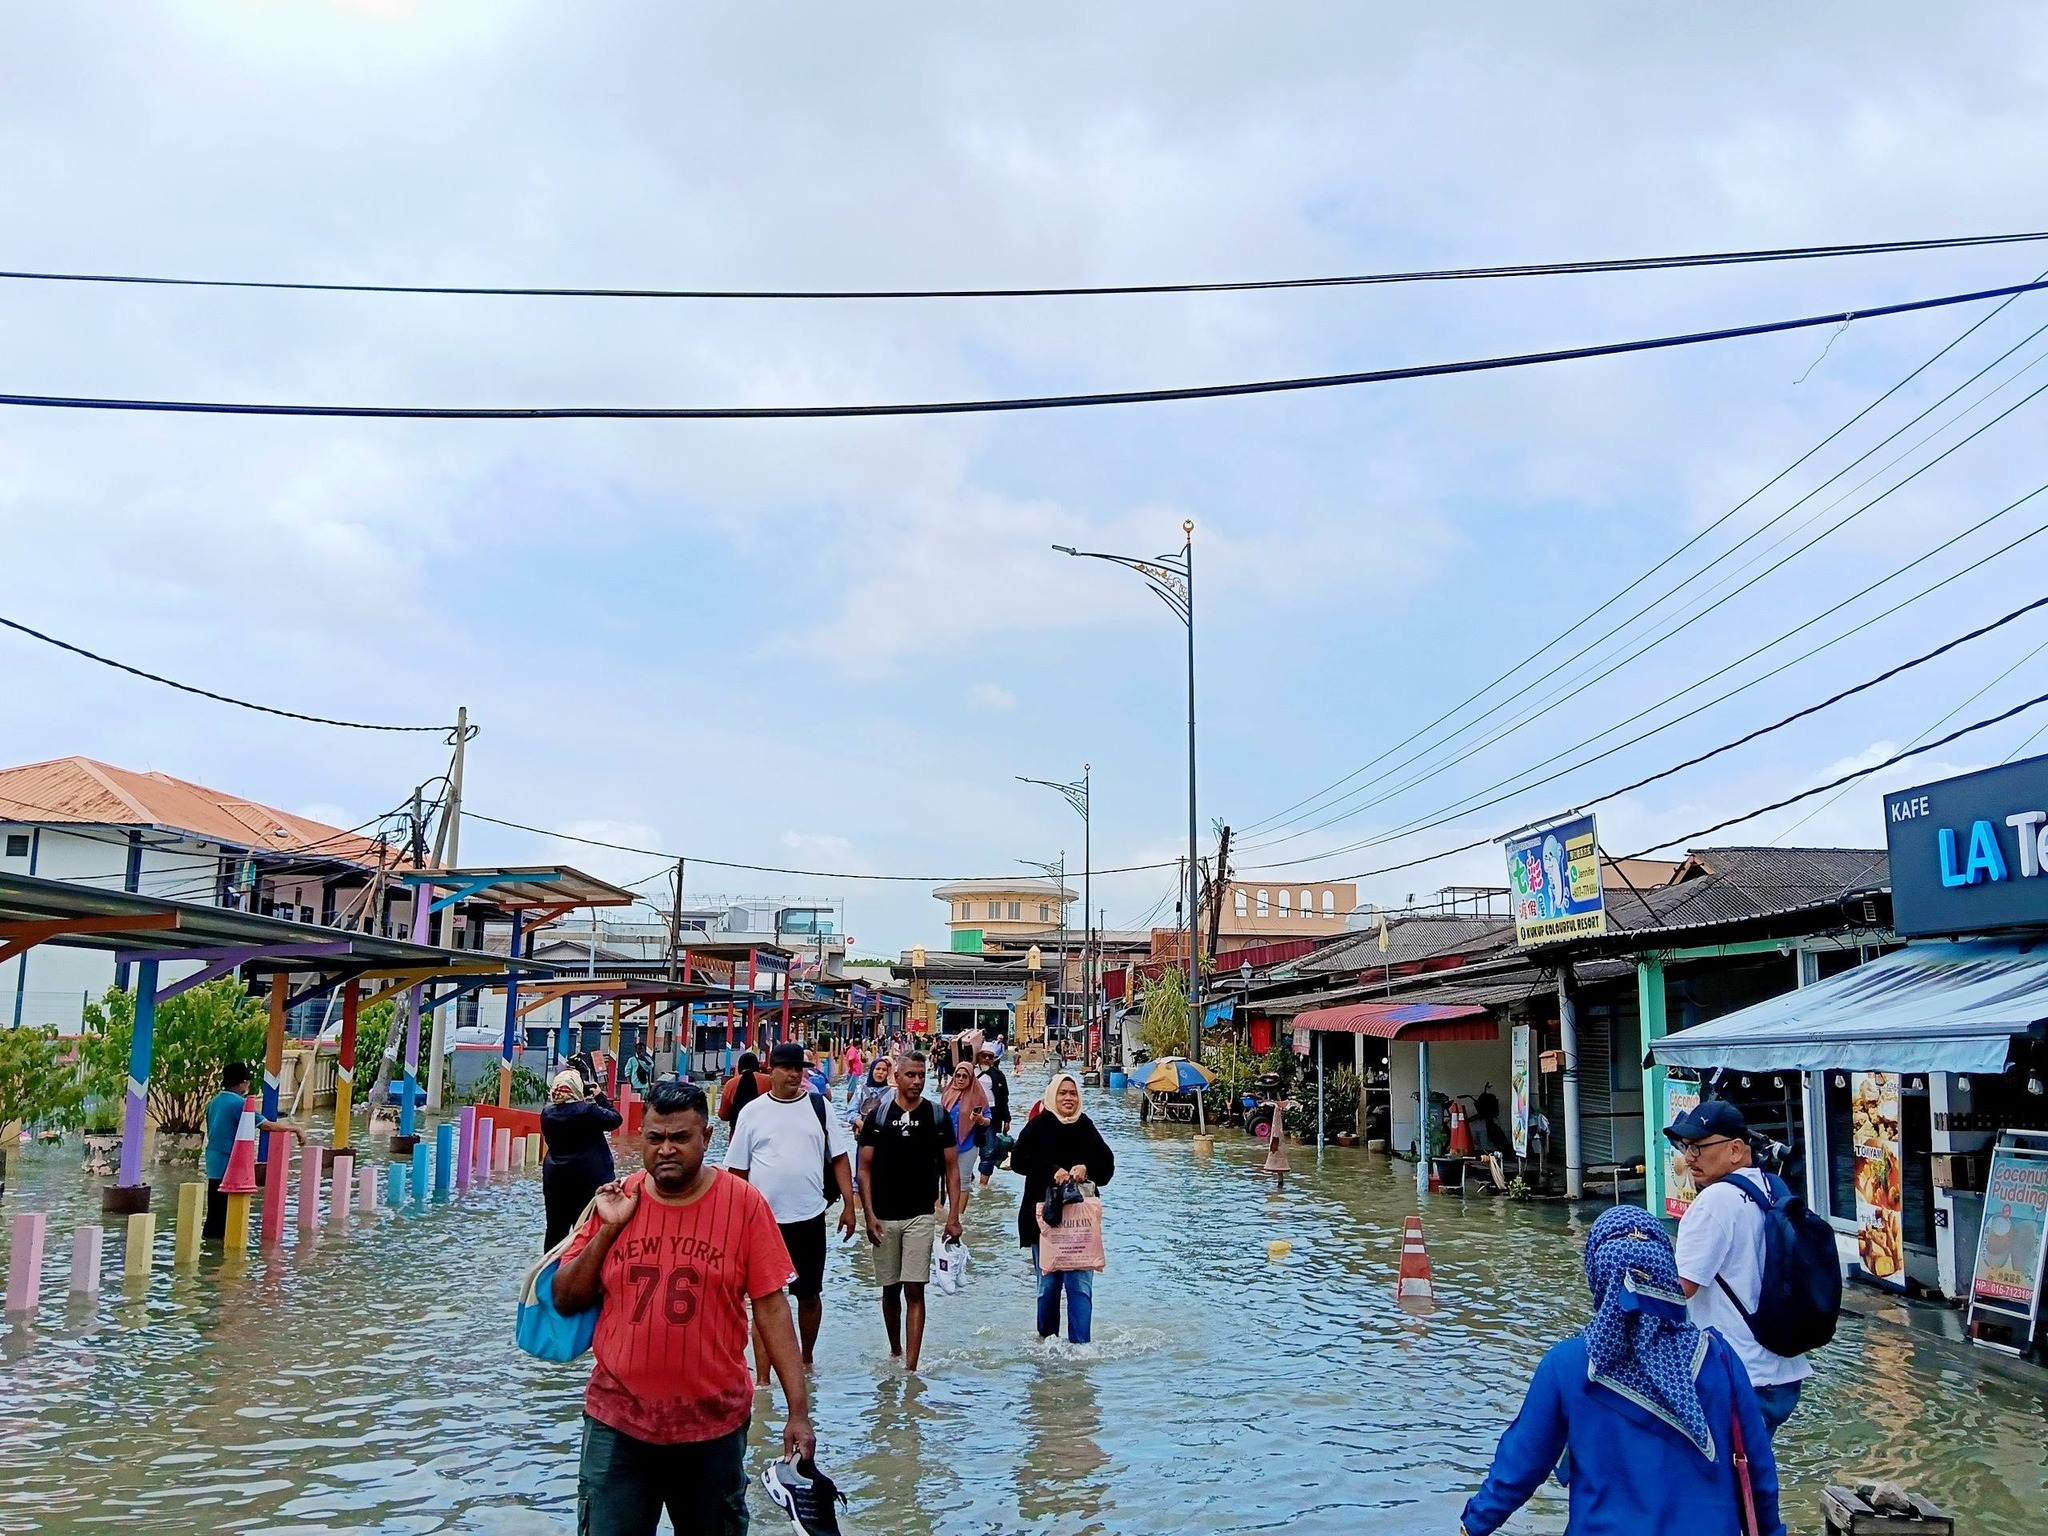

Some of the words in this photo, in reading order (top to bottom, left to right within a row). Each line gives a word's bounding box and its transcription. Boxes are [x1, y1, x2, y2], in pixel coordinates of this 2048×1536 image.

[1892, 796, 1930, 822] KAFE
[1938, 820, 2008, 887] LA
[1526, 925, 1545, 939] KUKUP
[1545, 919, 1577, 936] COLOURFUL
[1577, 915, 1599, 931] RESORT
[807, 936, 838, 945] HOTEL
[892, 1119, 919, 1127] GUSS
[1991, 1181, 2047, 1212] Pudding
[613, 1236, 663, 1266] NEW
[669, 1235, 726, 1271] YORK
[627, 1264, 702, 1327] 76
[1975, 1279, 1987, 1290] HP
